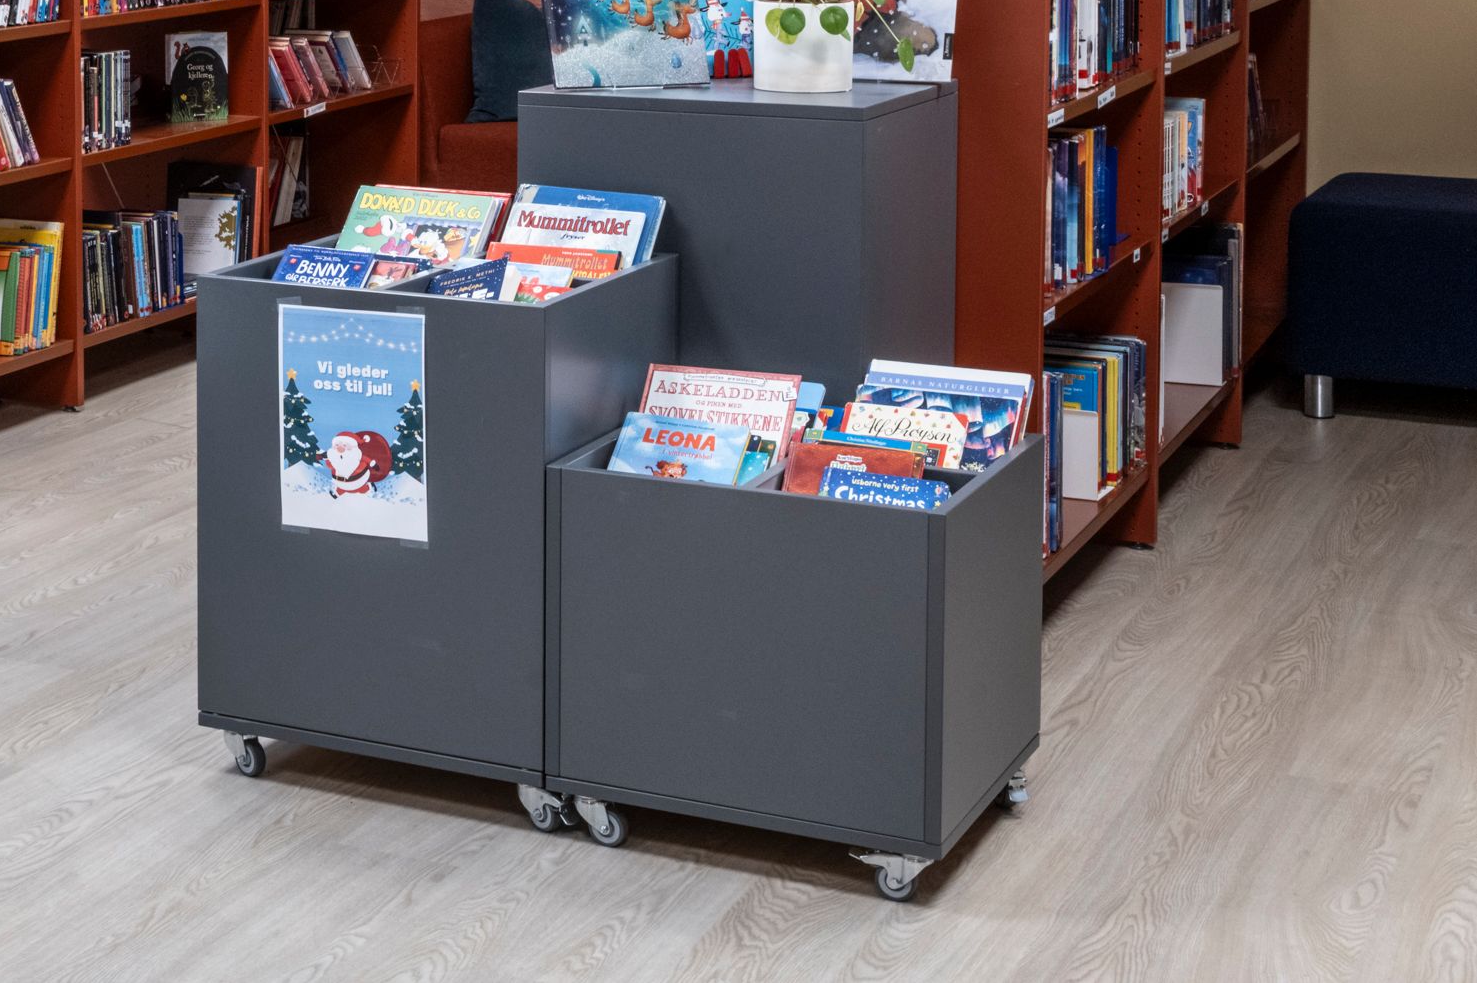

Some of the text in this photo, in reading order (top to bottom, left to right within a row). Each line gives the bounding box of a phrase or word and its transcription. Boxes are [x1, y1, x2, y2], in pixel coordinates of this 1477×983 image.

[187, 63, 205, 71] Georg
[359, 192, 415, 214] DONALD
[418, 196, 460, 218] DUCK
[517, 210, 632, 236] Mummitrollet
[295, 259, 350, 278] BENNY
[541, 254, 608, 270] Mummitrollet
[317, 360, 389, 380] Vi gleder
[313, 380, 393, 397] oss til jul!
[654, 380, 782, 402] ASKELADDEN
[880, 376, 1011, 395] BARNAS NATURGLEDER
[642, 427, 716, 452] LEONA
[851, 417, 957, 443] Alf Prøysen
[834, 485, 925, 509] Christmas
[882, 481, 920, 493] very first
